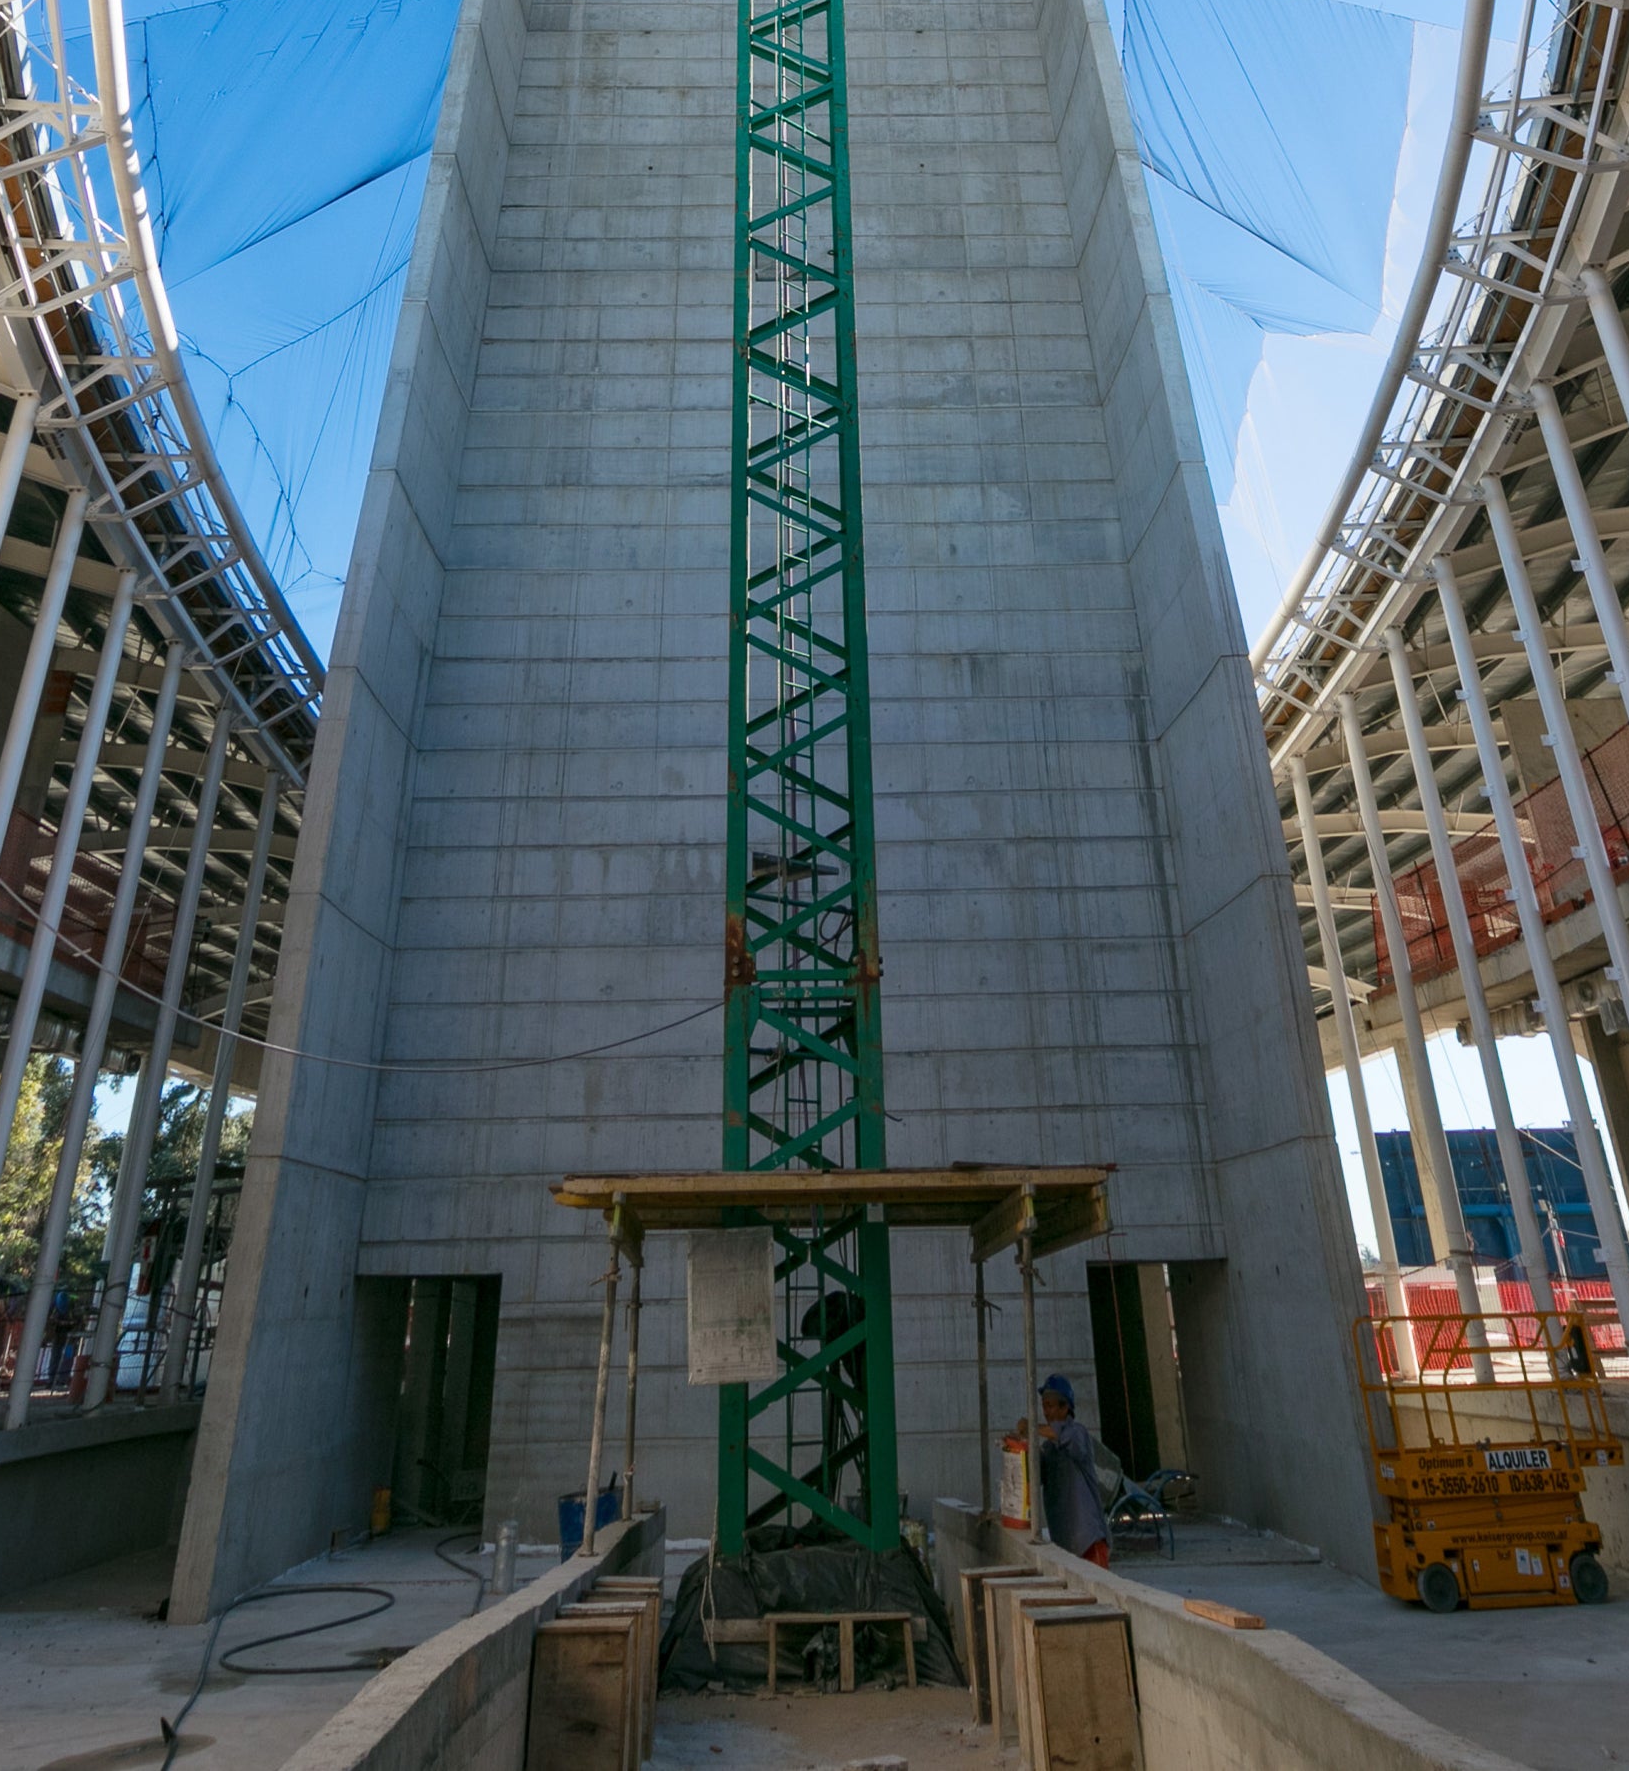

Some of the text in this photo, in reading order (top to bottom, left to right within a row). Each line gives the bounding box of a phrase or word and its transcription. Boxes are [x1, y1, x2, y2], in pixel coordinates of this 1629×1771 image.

[1419, 1457, 1464, 1471] Optimum
[1488, 1450, 1549, 1470] ALQUILER
[1421, 1475, 1499, 1496] 15-3550-2610
[1451, 1530, 1568, 1544] www.keisergroup.com.ar
